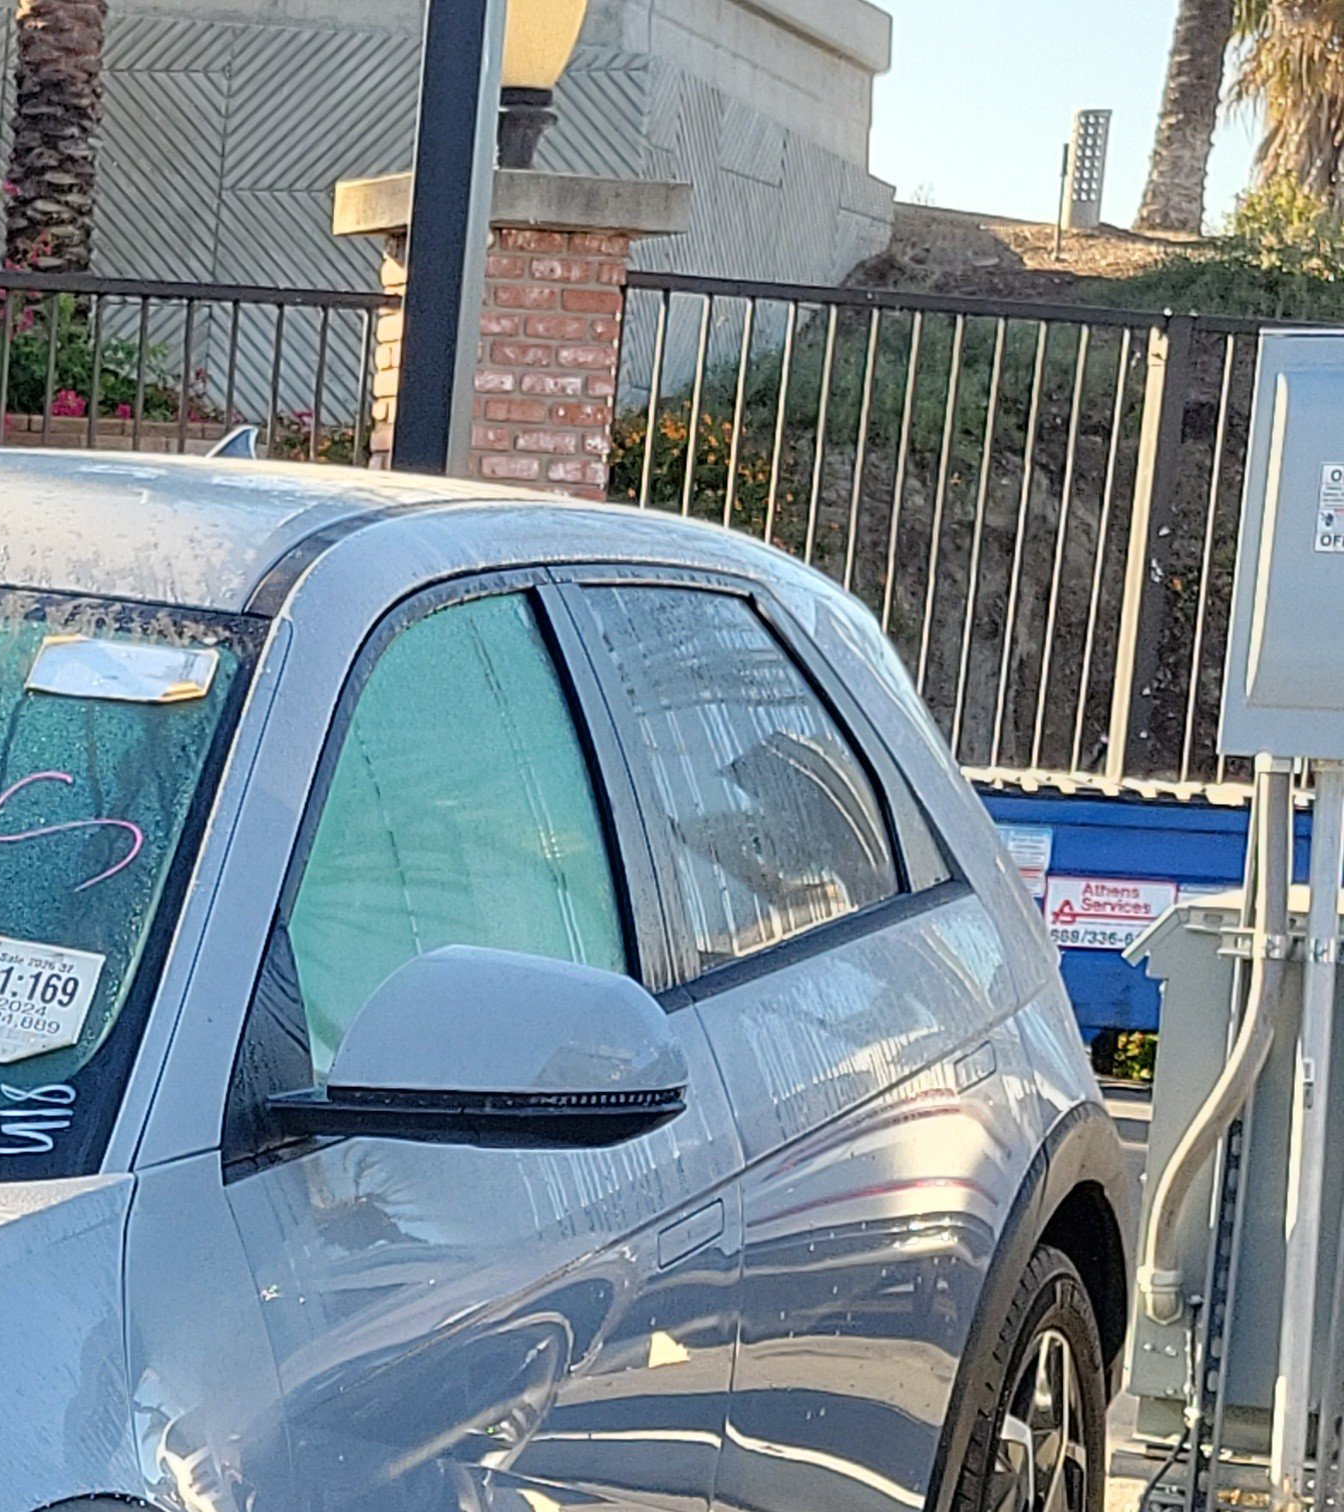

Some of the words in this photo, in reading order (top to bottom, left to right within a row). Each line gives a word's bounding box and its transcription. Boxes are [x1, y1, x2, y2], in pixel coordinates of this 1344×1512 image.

[1320, 534, 1344, 547] OF
[1081, 882, 1140, 899] Athens
[1081, 898, 1151, 914] Services
